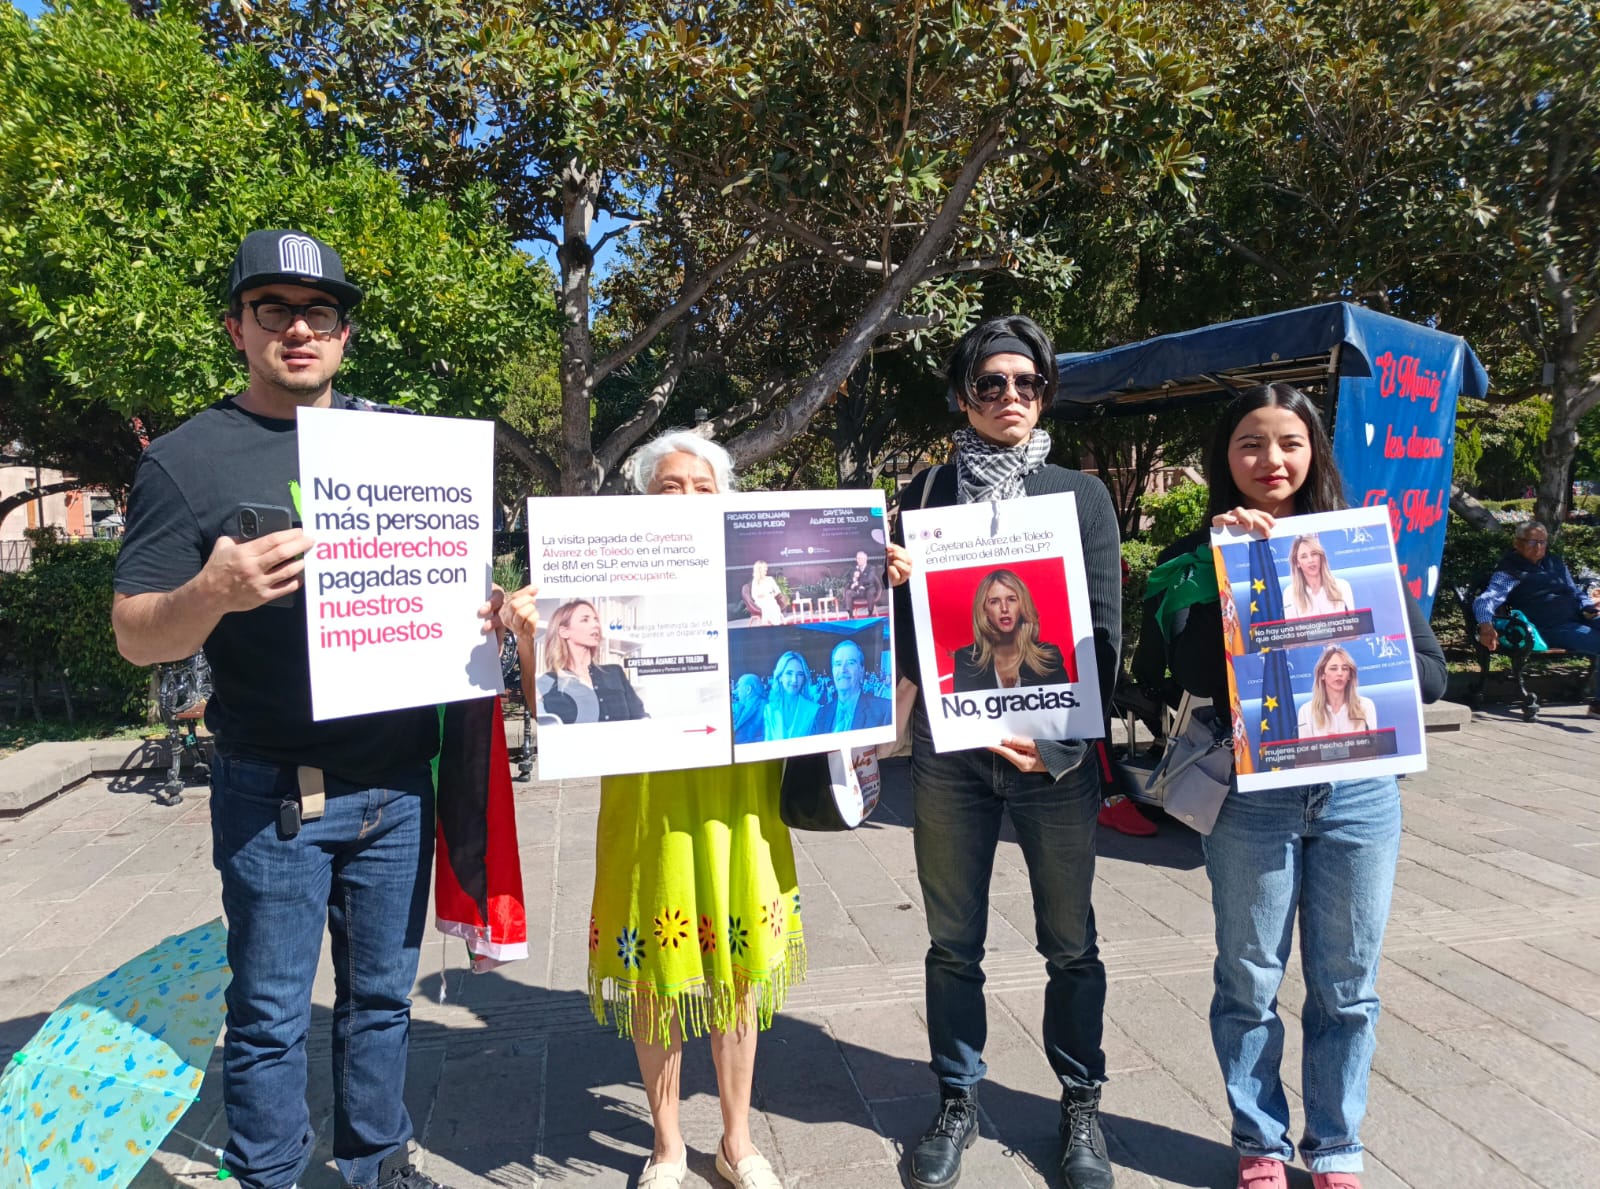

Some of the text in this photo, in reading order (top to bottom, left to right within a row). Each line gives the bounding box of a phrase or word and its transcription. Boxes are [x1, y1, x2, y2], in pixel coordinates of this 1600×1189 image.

[313, 477, 472, 507] No queremos
[315, 507, 479, 535] más personas
[727, 513, 756, 521] RICARDO
[846, 515, 869, 523] TOLEDO
[733, 521, 762, 529] SALINAS
[542, 532, 692, 546] La visita pagada de Cayetana
[925, 530, 1054, 555] ¿Cayetana Álvarez de Toledo
[316, 536, 468, 560] antiderechos
[584, 547, 597, 557] de
[600, 546, 634, 557] Toledo
[636, 547, 650, 555] en
[651, 545, 661, 555] el
[663, 546, 696, 554] marco
[926, 542, 1051, 565] en el marco del 8M en SLP?
[543, 560, 559, 571] del
[562, 560, 577, 570] 8M
[580, 561, 594, 569] en
[651, 559, 664, 567] un
[666, 557, 709, 568] mensaje
[318, 565, 467, 595] pagadas con
[543, 570, 677, 584] institucional preocupante.
[319, 594, 423, 619] nuestros
[320, 622, 443, 651] impuestos
[1265, 627, 1280, 636] hay
[1281, 625, 1294, 633] una
[1256, 635, 1270, 643] que
[941, 687, 1081, 720] No, gracias.
[1297, 745, 1309, 753] por
[1319, 741, 1343, 750] hecho
[1344, 739, 1354, 747] de
